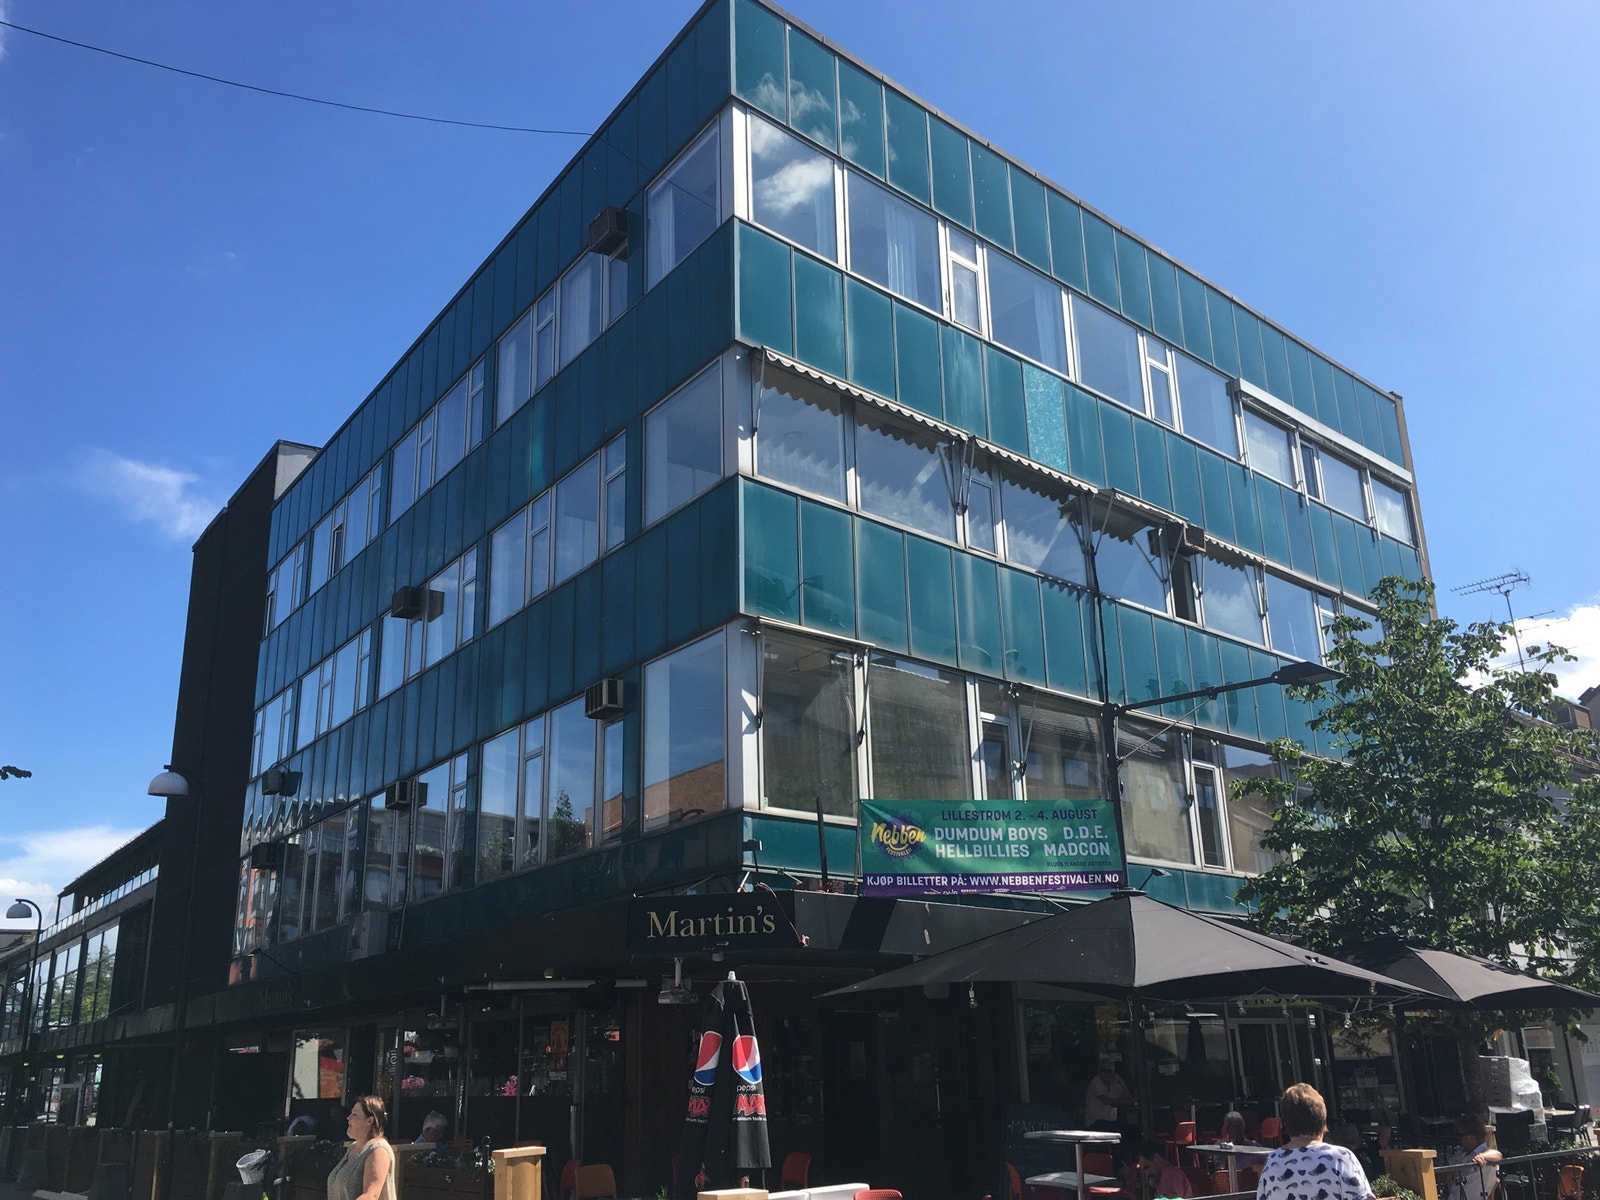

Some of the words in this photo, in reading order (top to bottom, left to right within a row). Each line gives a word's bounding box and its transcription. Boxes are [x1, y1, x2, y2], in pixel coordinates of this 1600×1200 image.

[941, 809, 1011, 821] LILLESTRØM
[1014, 809, 1026, 821] 2.
[1037, 809, 1049, 821] 4.
[1052, 808, 1098, 820] AUGUST
[934, 827, 1003, 841] DUMDUM
[1008, 827, 1048, 841] BOYS
[1063, 825, 1108, 840] D.D.E.
[935, 843, 1030, 858] HELLBILLIES
[1043, 841, 1111, 857] MADCON
[866, 876, 894, 886] KJØP
[896, 875, 948, 886] BILLETTER
[951, 873, 967, 886] PÅ:
[969, 873, 1119, 887] WWW.NEBBENFESTIVALEN.NO
[647, 905, 776, 938] Martin's
[691, 1086, 706, 1094] epsi
[736, 1084, 757, 1092] pepsi
